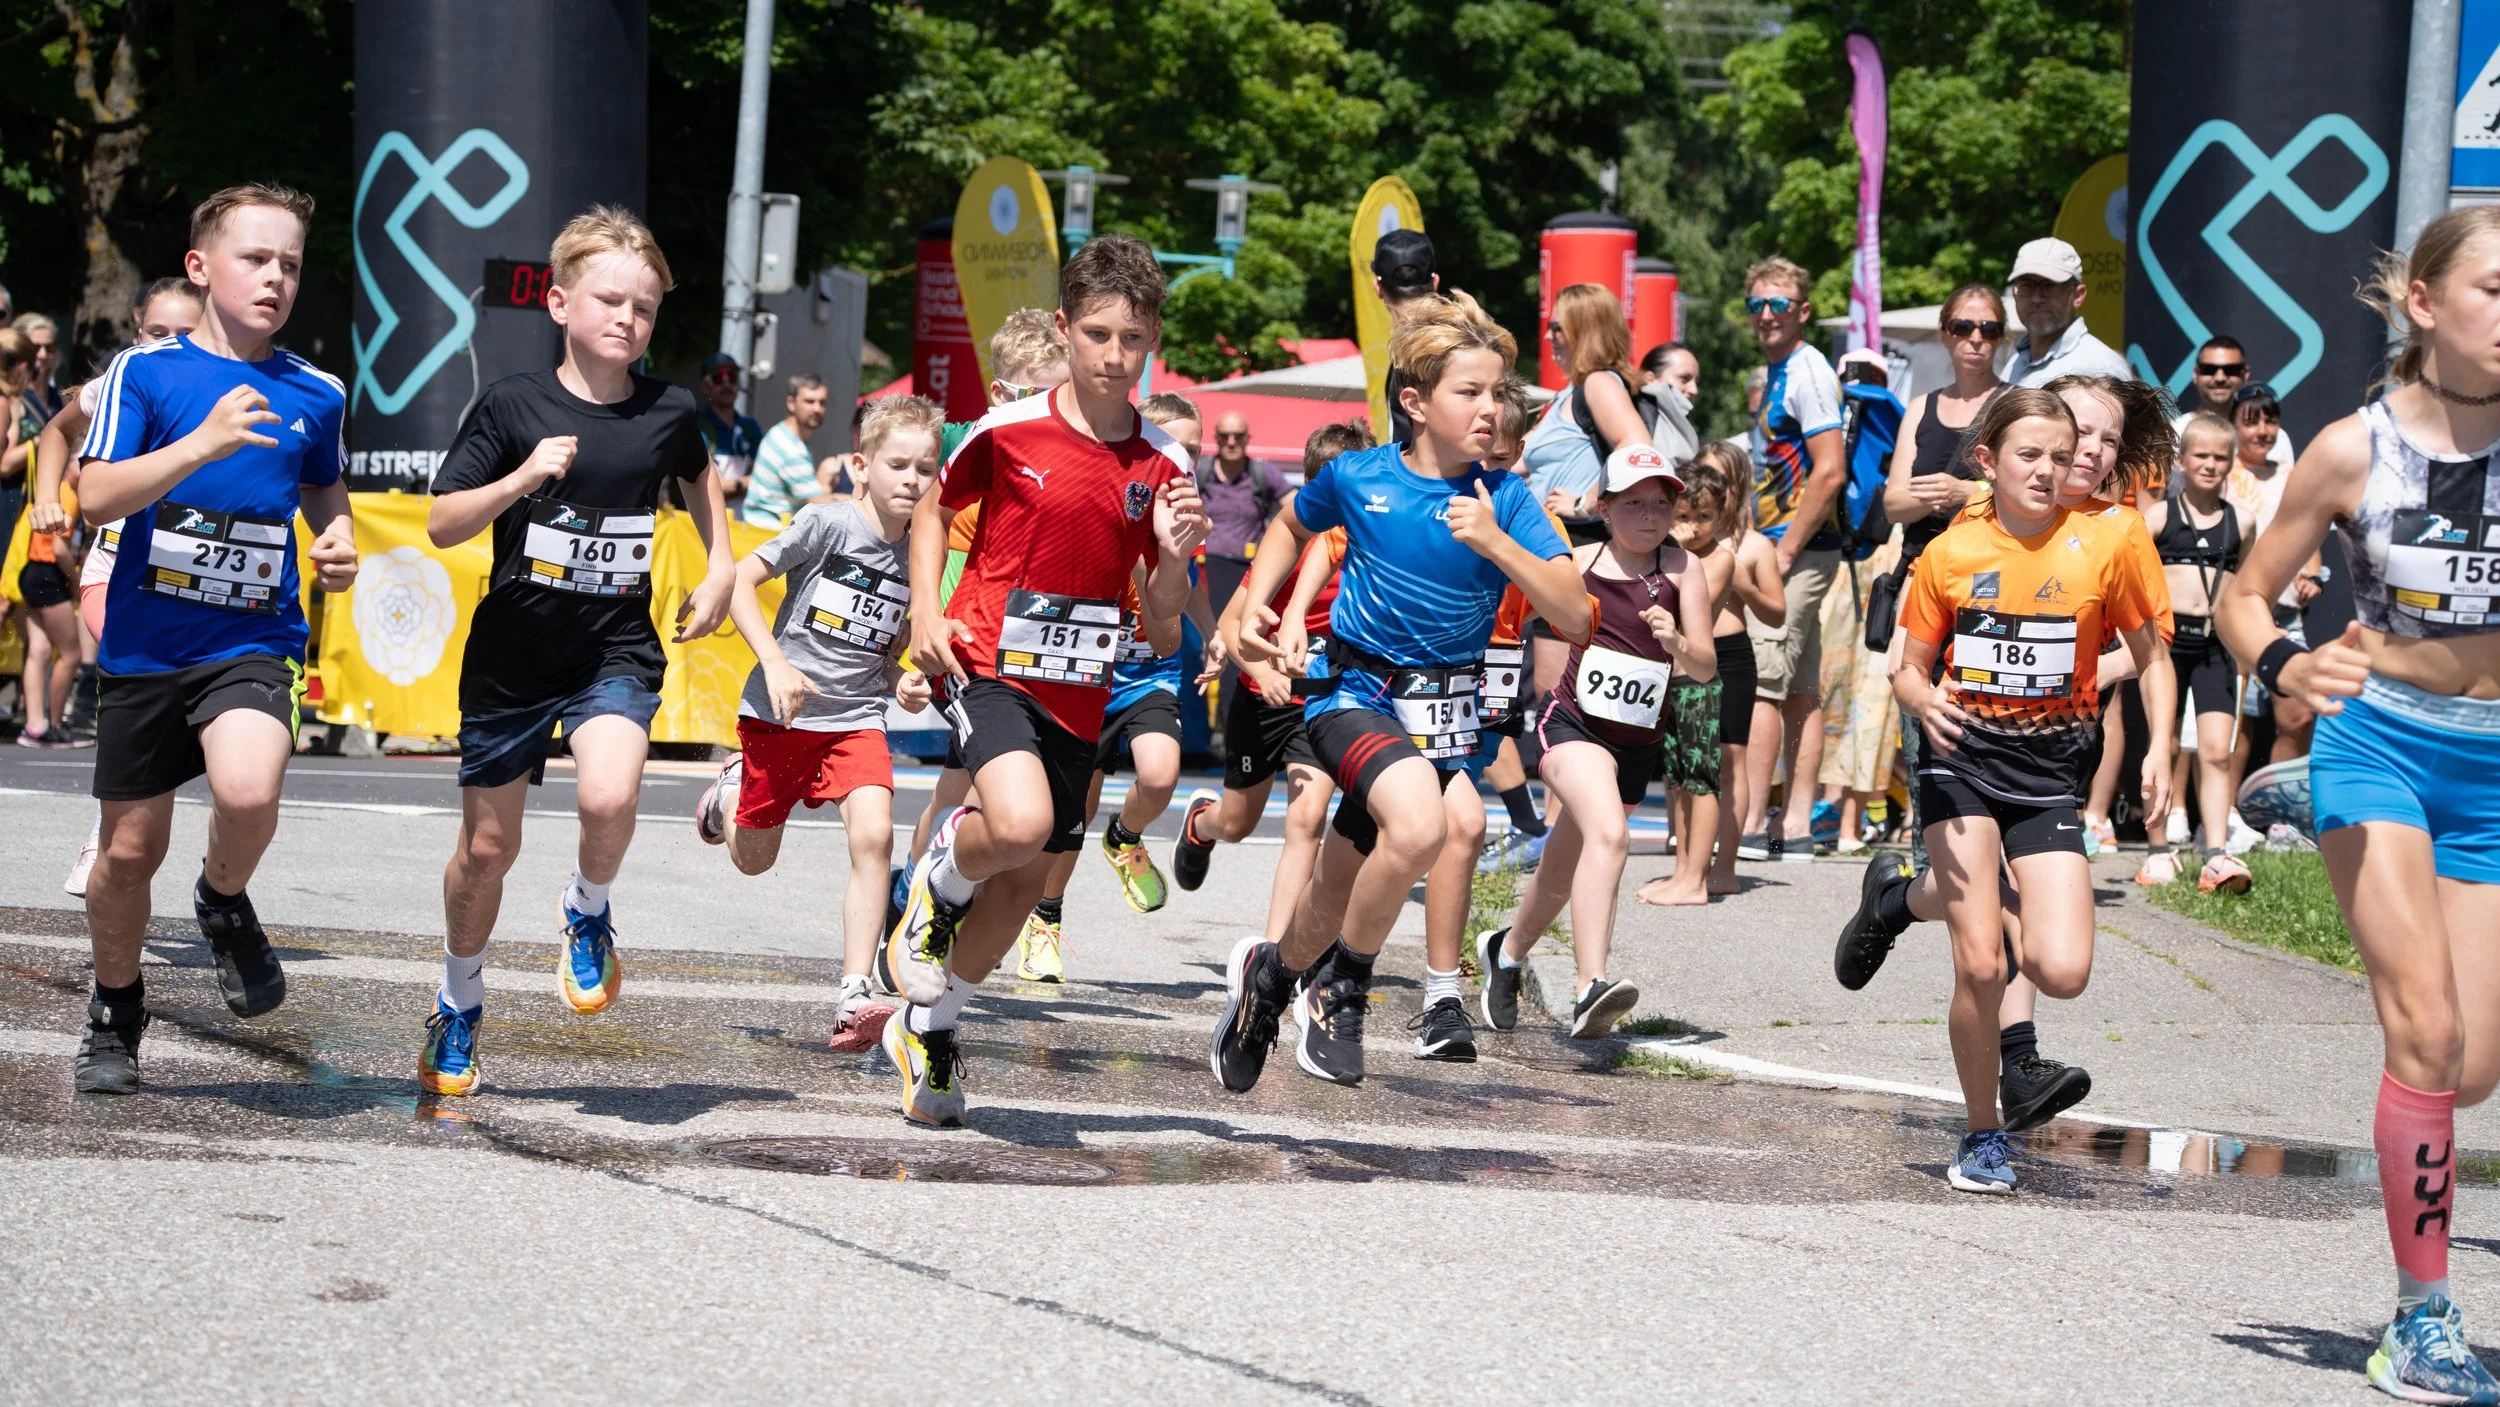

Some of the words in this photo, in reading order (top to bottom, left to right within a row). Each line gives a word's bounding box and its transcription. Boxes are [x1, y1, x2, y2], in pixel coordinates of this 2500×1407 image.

[192, 543, 247, 573] 273
[569, 538, 617, 563] 160
[2445, 556, 2500, 585] 158
[2454, 586, 2489, 594] MELISSA
[851, 594, 886, 621] 154
[1040, 625, 1081, 649] 151
[1992, 642, 2037, 667] 186
[1587, 670, 1657, 709] 9304
[1242, 755, 1252, 773] 8
